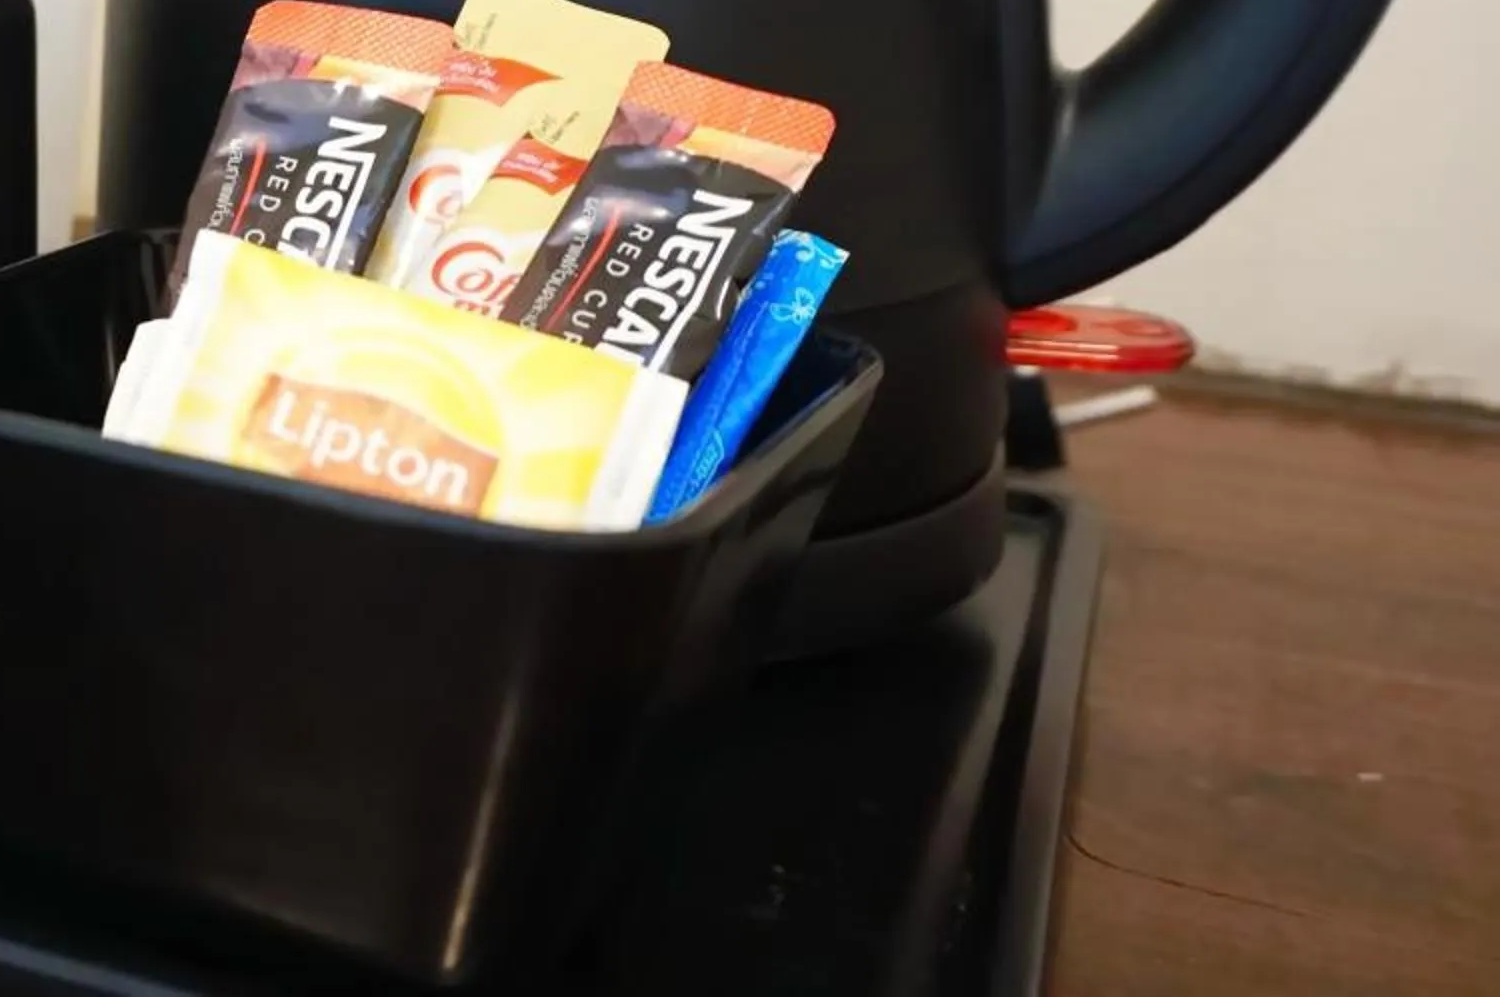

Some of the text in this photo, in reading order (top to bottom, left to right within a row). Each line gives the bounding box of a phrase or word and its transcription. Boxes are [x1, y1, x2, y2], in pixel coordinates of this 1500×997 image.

[259, 155, 298, 212] RED
[606, 223, 654, 278] RED
[268, 389, 469, 504] Lipton
